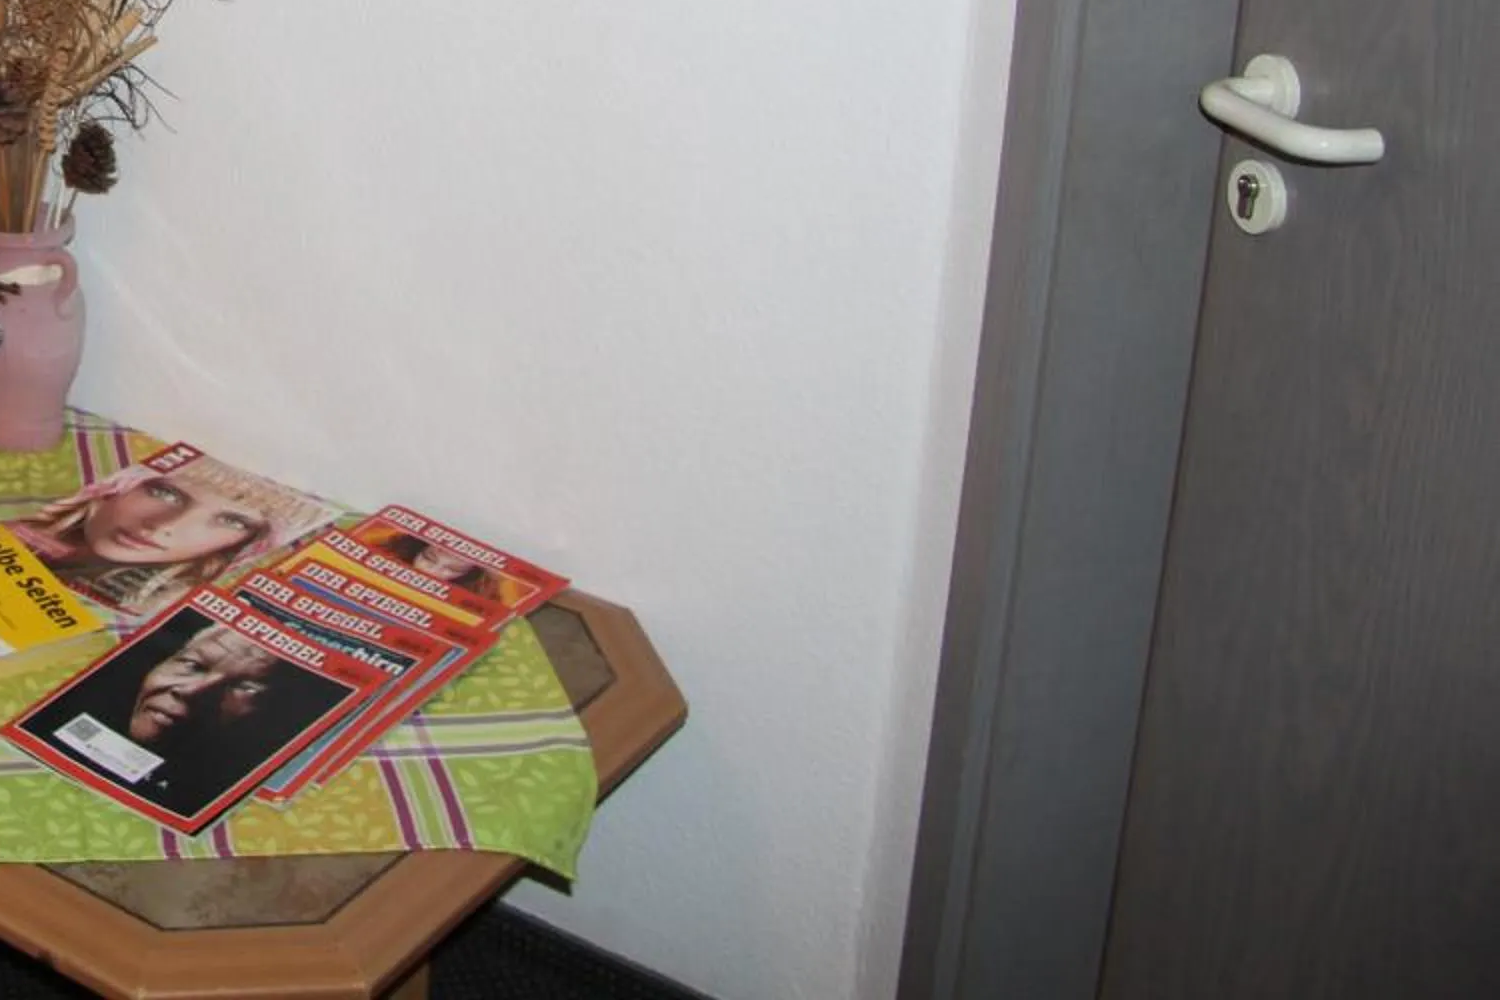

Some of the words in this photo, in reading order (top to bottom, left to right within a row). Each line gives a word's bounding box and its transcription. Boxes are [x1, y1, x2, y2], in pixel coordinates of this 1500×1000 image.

[324, 530, 368, 561] DER
[365, 553, 451, 600] SPIEGEL
[381, 506, 422, 533] DER
[422, 525, 507, 570] SPIEGEL
[15, 576, 78, 629] Seiten
[194, 589, 241, 622] DER
[237, 613, 327, 668] SPIEGEL
[249, 573, 294, 604] DER
[296, 596, 384, 640] SPIEGEL
[300, 561, 347, 590] DER
[344, 580, 434, 629] SPIEGEL
